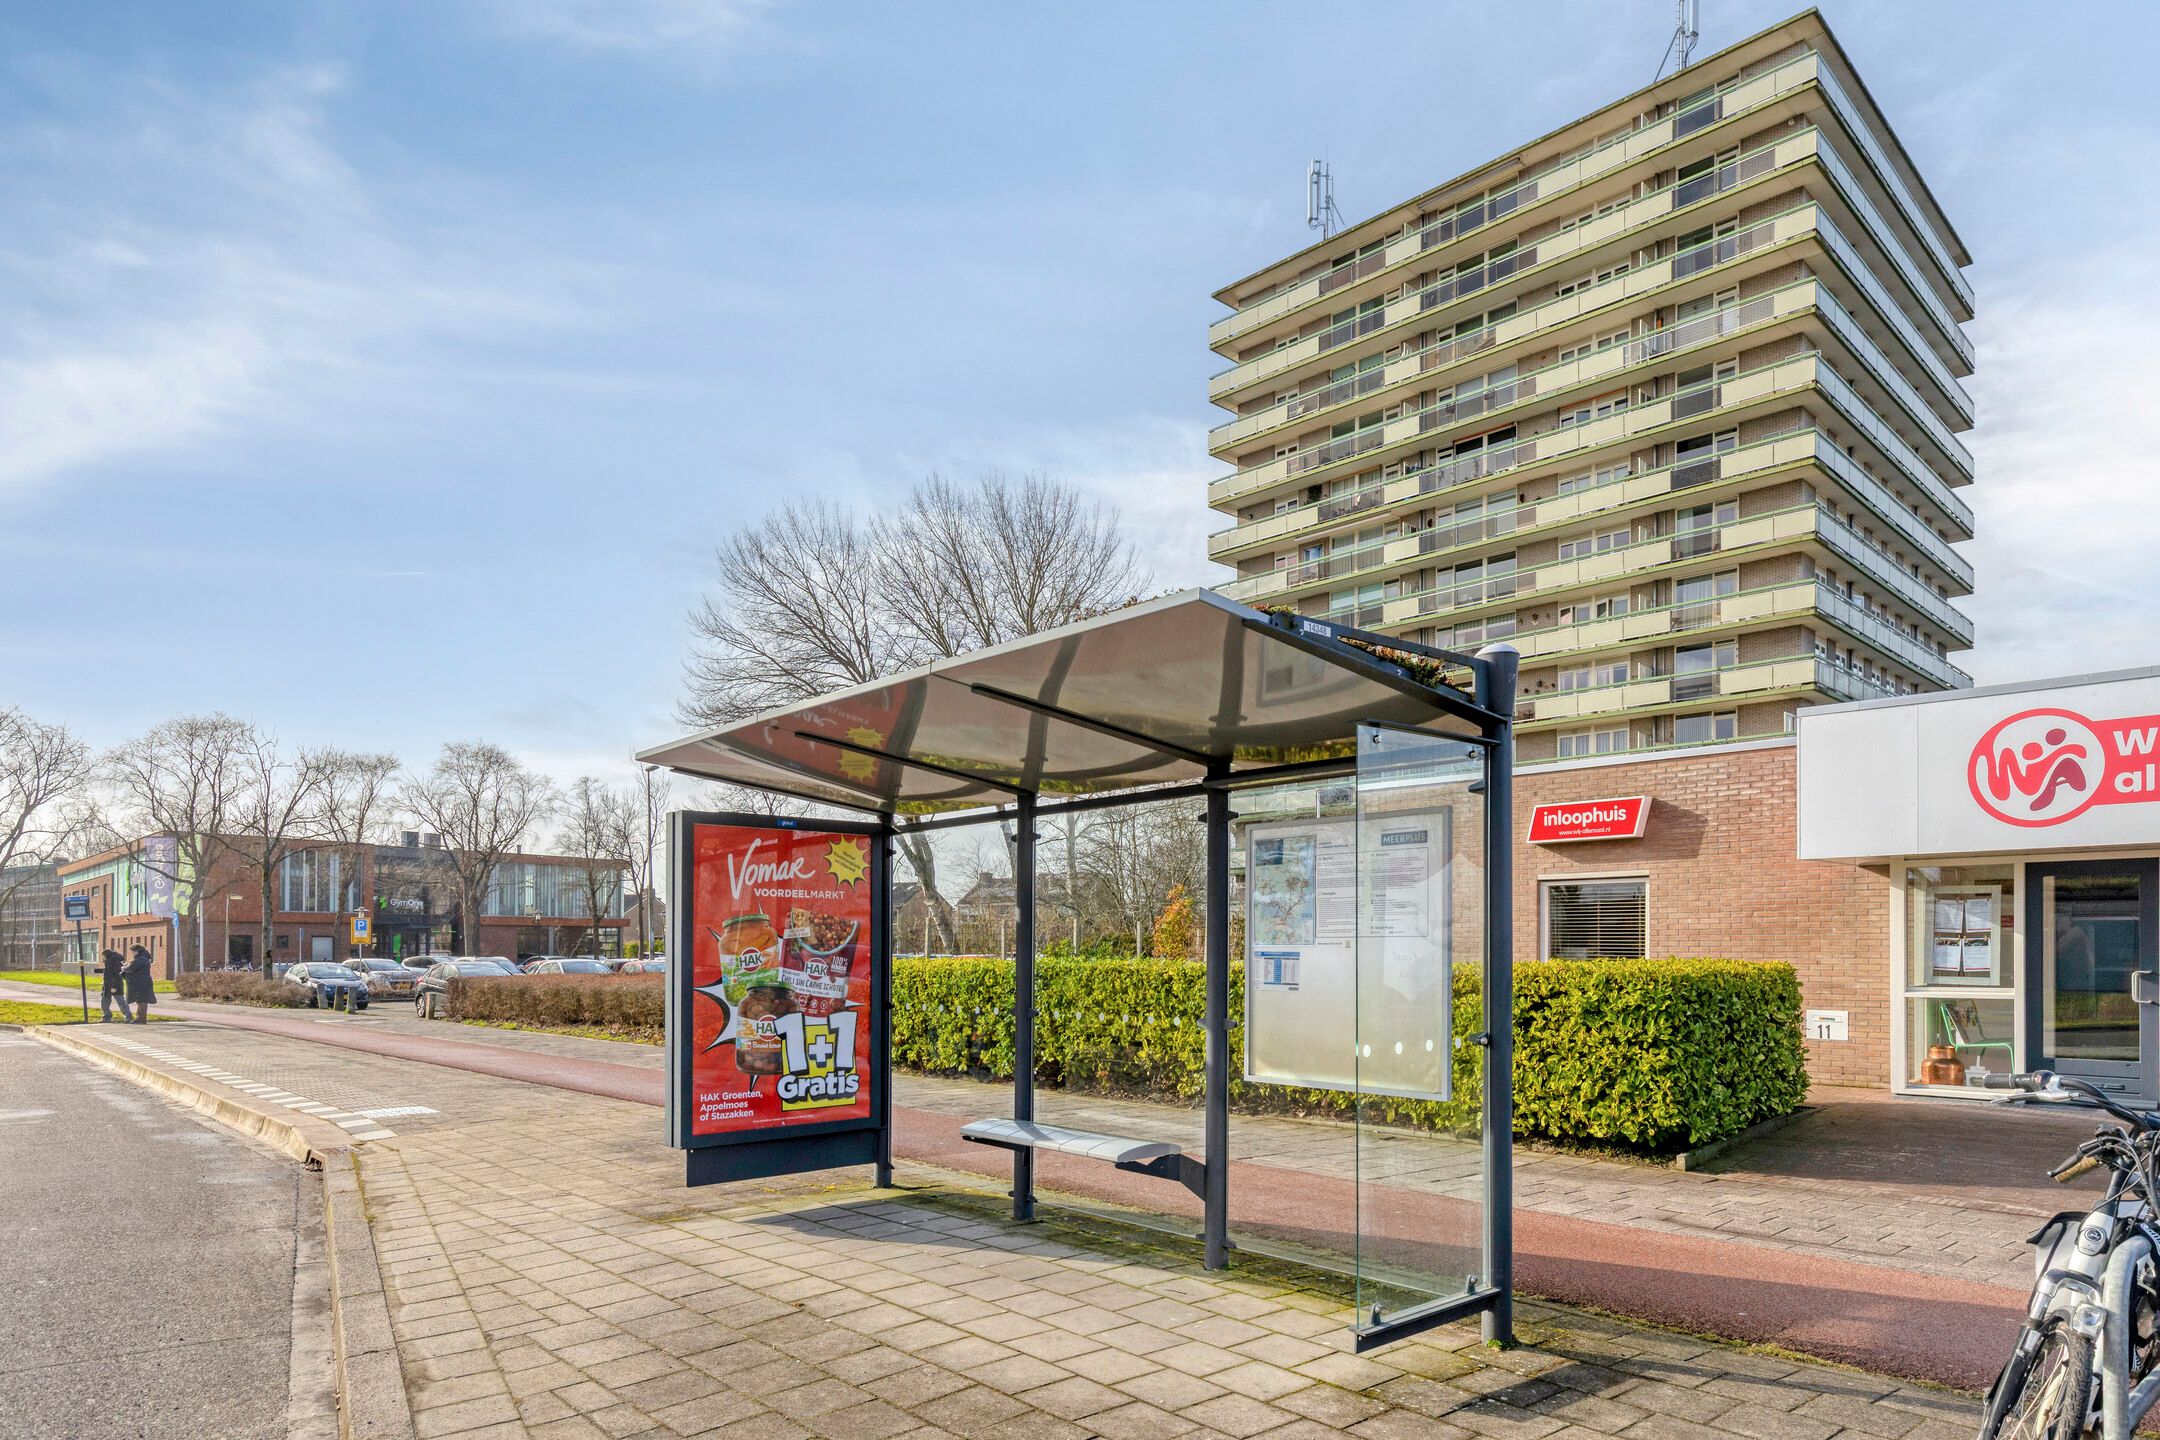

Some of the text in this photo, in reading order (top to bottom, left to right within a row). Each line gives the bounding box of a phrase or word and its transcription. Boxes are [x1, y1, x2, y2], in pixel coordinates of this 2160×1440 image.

[2114, 763, 2160, 793] al
[1543, 805, 1627, 827] inloophuis
[1383, 832, 1426, 844] MEERPLUS
[754, 888, 845, 900] VOORDEELMARKT
[357, 920, 365, 930] P
[739, 953, 763, 968] HAK
[805, 962, 828, 976] HAK
[806, 979, 823, 990] CARNE
[756, 1021, 776, 1034] HA
[1817, 1024, 1831, 1039] 11
[774, 1010, 857, 1074] 1+1
[777, 1069, 860, 1100] Gratis
[700, 1090, 763, 1102] HAK Groenten,
[700, 1101, 748, 1112] Appelmoes
[699, 1112, 709, 1121] of
[711, 1110, 754, 1120] Stazakken
